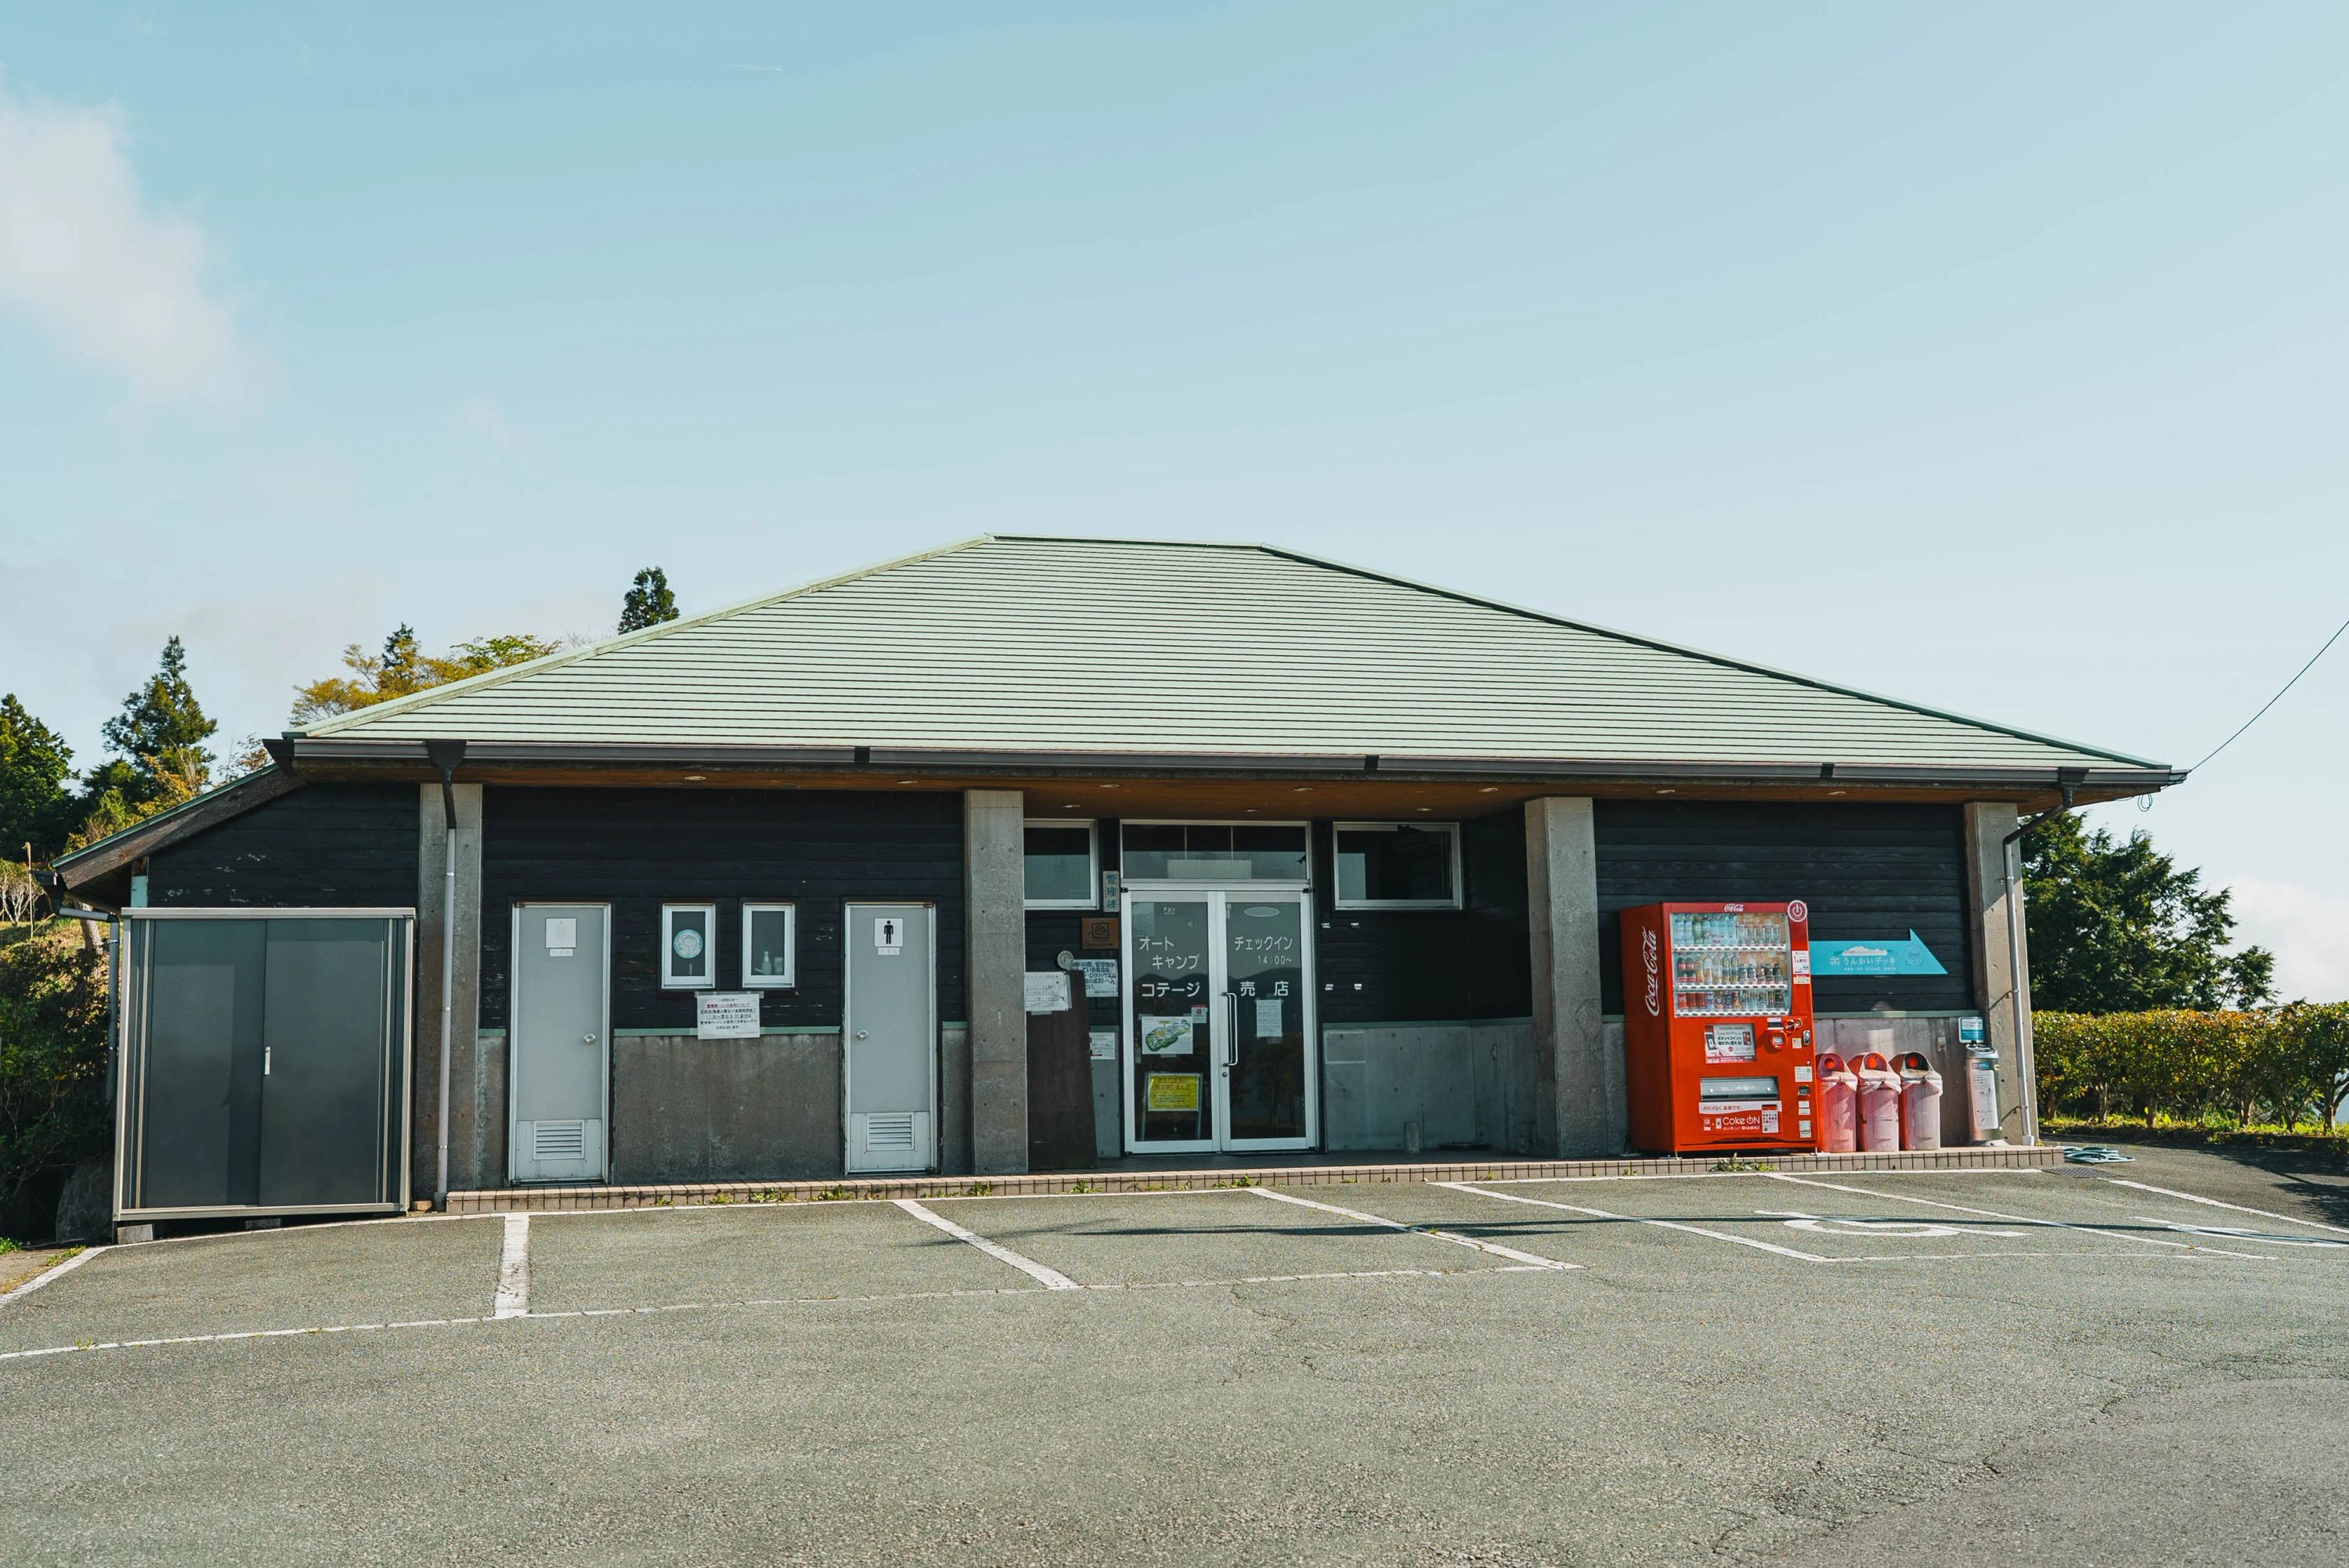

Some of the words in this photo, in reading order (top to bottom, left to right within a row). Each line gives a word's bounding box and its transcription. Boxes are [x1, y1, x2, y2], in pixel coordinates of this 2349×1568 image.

[1106, 874, 1117, 909] 管理棟
[1724, 903, 1745, 913] Coca-Cola
[1139, 936, 1174, 951] オート
[1234, 935, 1293, 951] チェックイン
[1152, 953, 1200, 970] キャンプ
[1642, 925, 1659, 1017] Coca-Cola
[1142, 982, 1200, 997] コテージ
[1723, 1116, 1745, 1125] Coke
